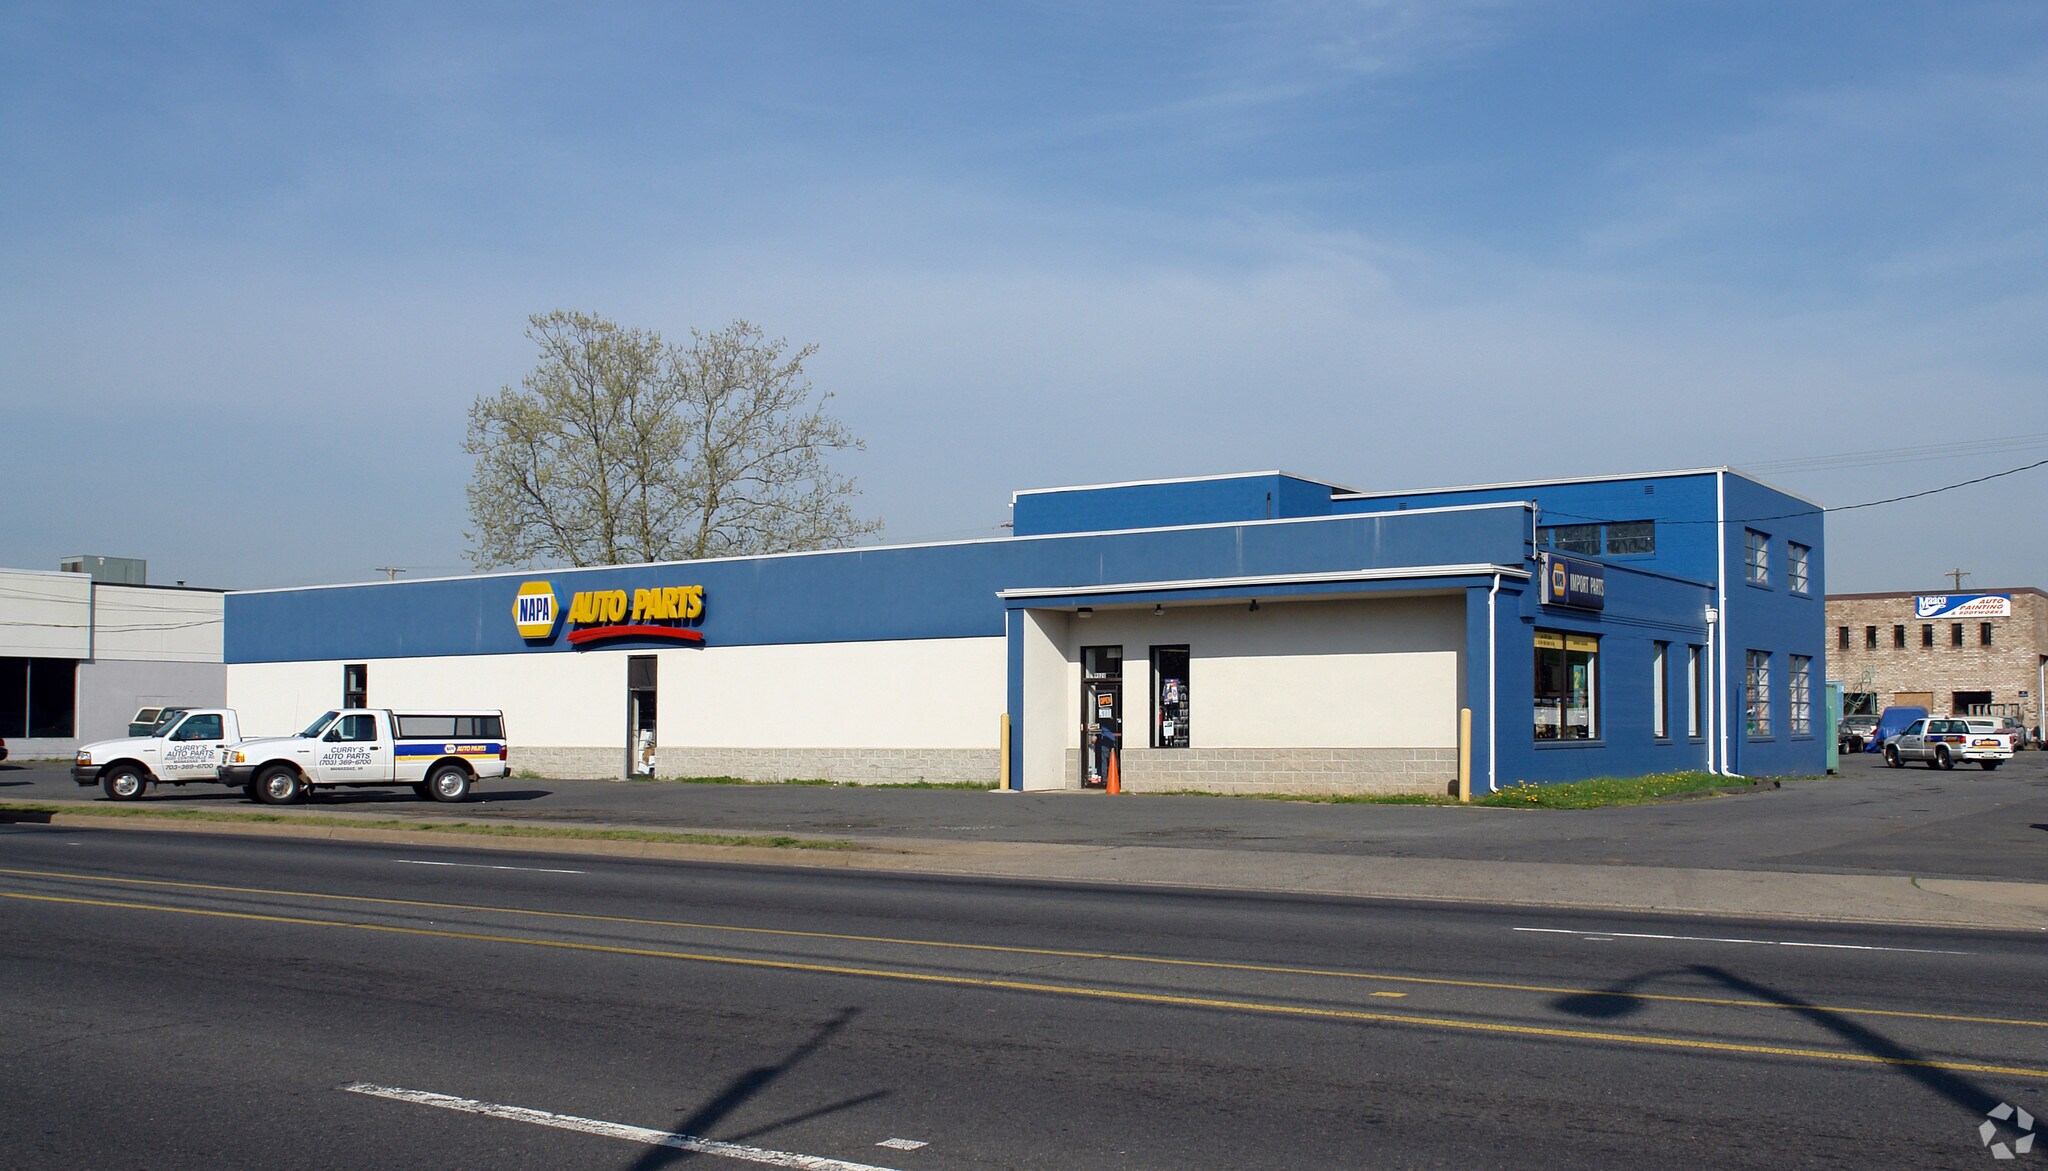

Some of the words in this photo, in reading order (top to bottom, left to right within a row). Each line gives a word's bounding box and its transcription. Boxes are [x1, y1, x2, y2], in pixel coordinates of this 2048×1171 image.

[1570, 573, 1589, 594] IMPORT
[1590, 577, 1604, 597] PARTS
[519, 596, 551, 622] NAPA
[567, 589, 629, 624] AUTO
[632, 585, 704, 621] PARTS
[1918, 597, 1947, 611] Maaco
[174, 744, 207, 752] CURRY'S
